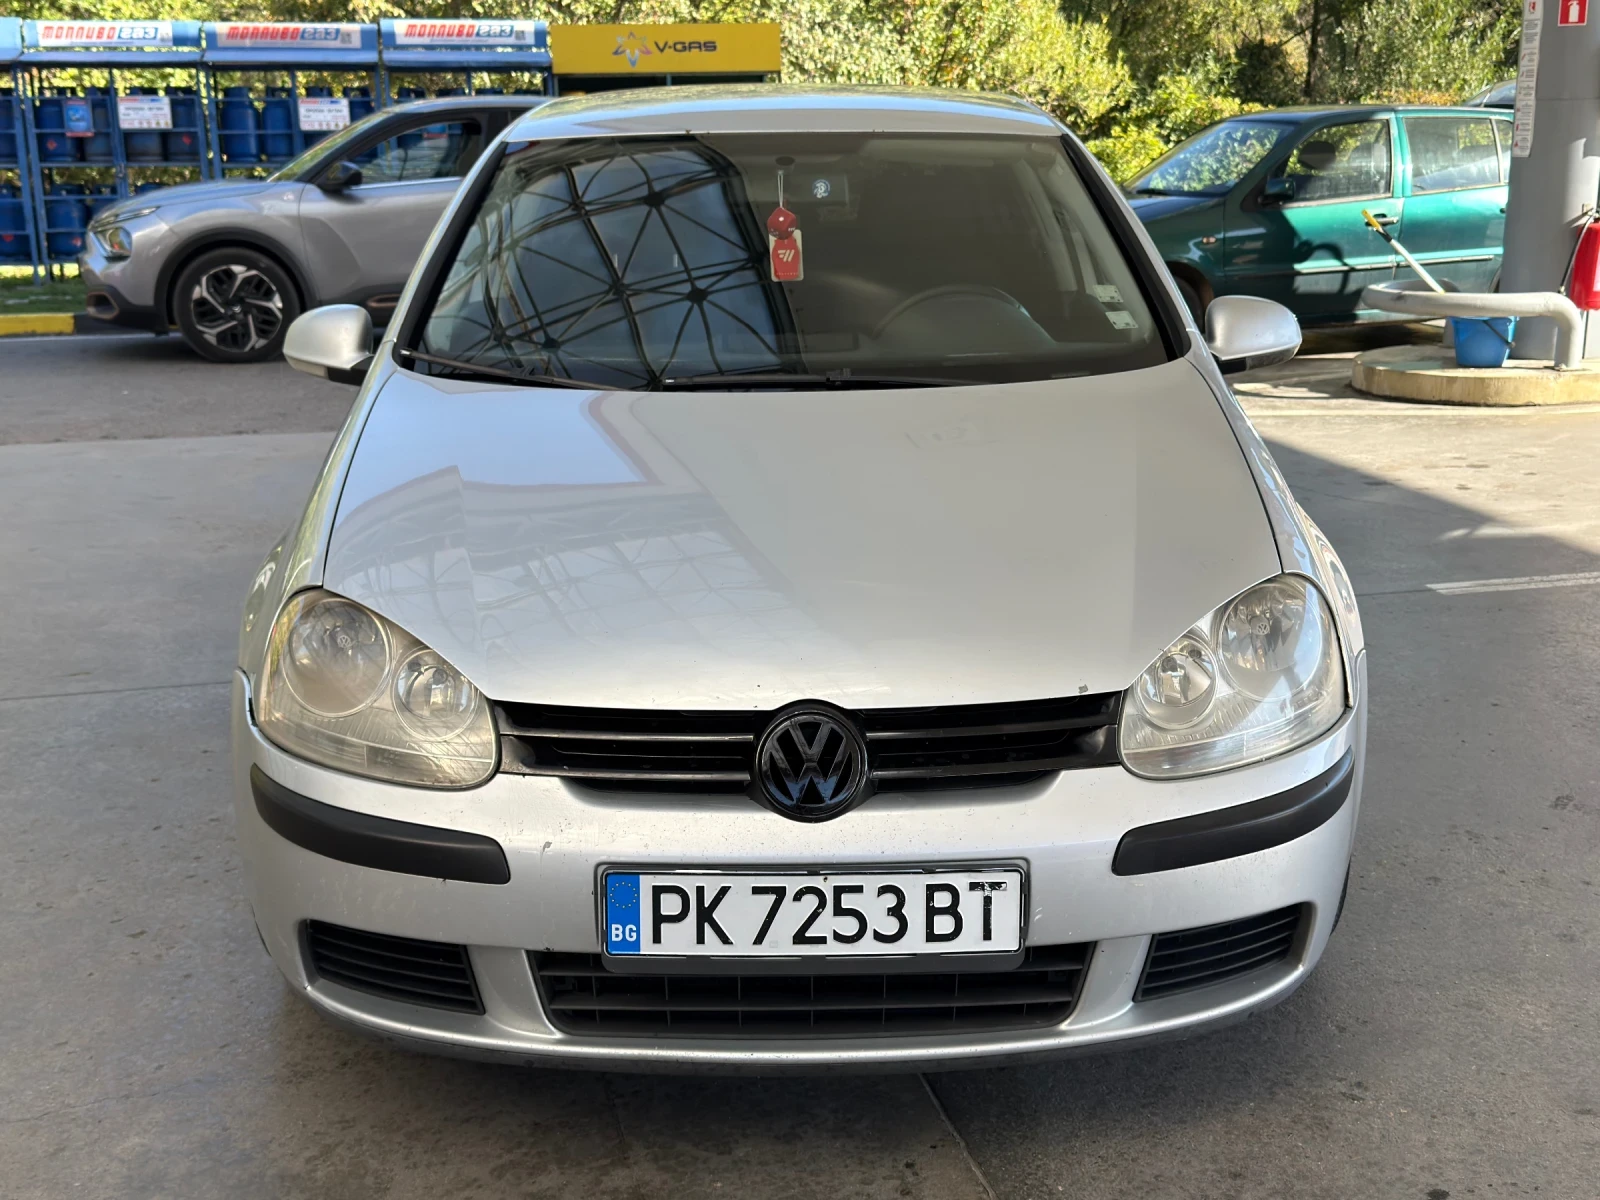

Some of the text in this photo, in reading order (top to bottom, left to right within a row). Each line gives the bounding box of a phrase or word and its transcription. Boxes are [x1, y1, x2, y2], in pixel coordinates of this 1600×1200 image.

[761, 713, 860, 810] VW
[611, 923, 637, 943] BG
[651, 881, 1008, 946] PK 7253 BT
